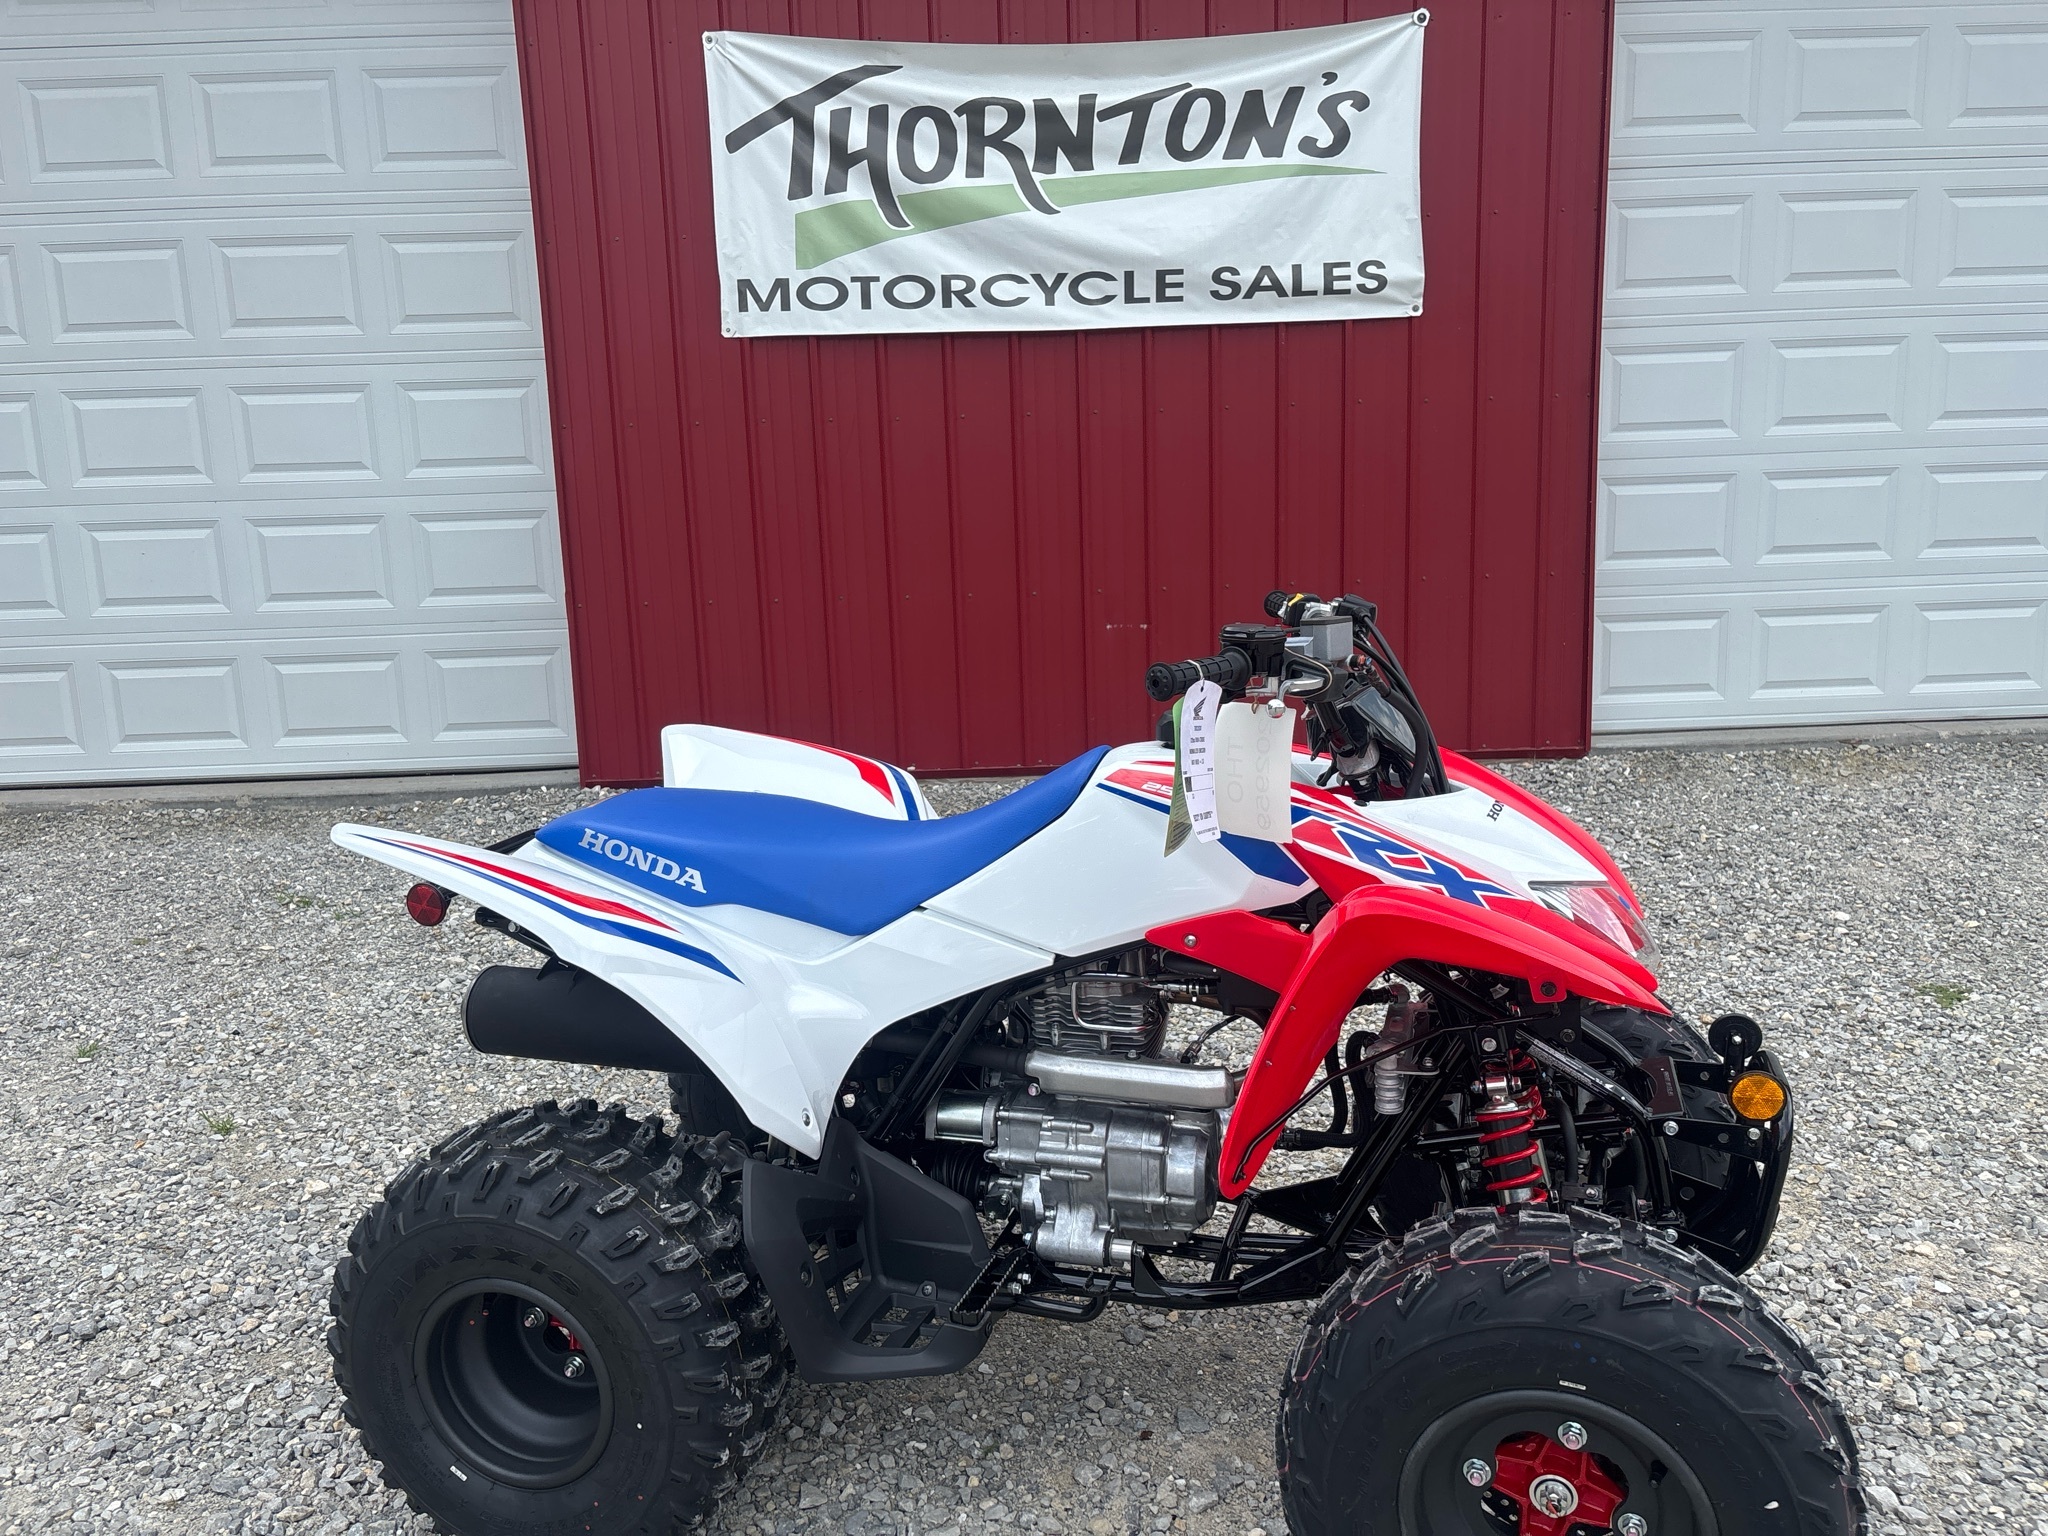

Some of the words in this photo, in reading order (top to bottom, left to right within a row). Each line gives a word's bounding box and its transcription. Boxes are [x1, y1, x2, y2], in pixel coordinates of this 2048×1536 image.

[726, 64, 1370, 229] THORNTON'S
[737, 268, 1185, 314] MOTORCYCLE
[1209, 259, 1389, 301] SALES
[578, 828, 708, 894] HONDA
